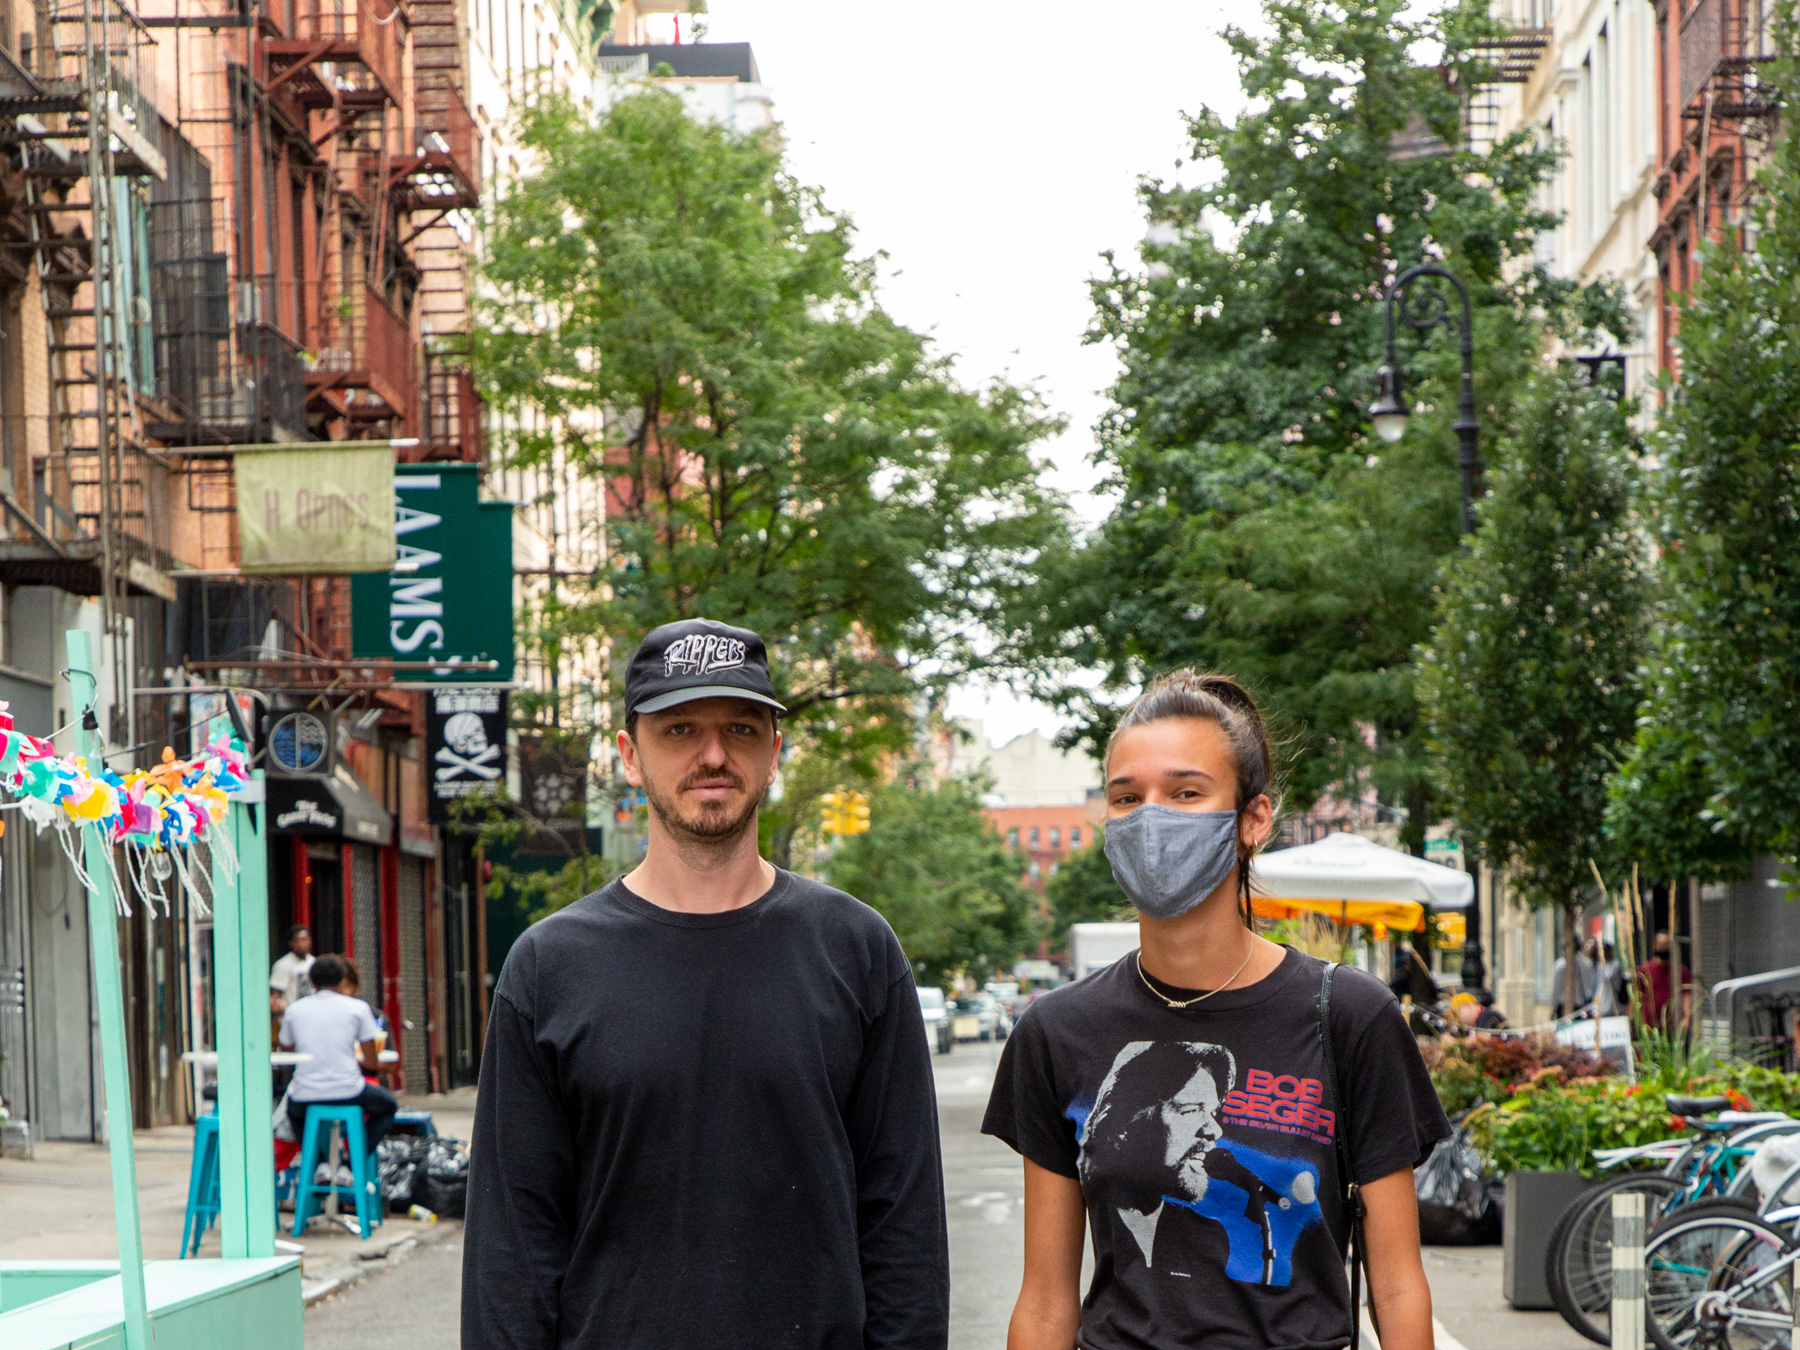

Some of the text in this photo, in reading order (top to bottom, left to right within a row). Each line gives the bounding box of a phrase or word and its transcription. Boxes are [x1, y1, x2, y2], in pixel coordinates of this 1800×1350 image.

[1245, 1068, 1323, 1106] BOB
[1221, 1090, 1336, 1137] SEGER
[1230, 1117, 1249, 1127] THE
[1248, 1119, 1280, 1132] SILVER
[1279, 1124, 1312, 1138] BULLET
[1310, 1132, 1333, 1146] BAND
